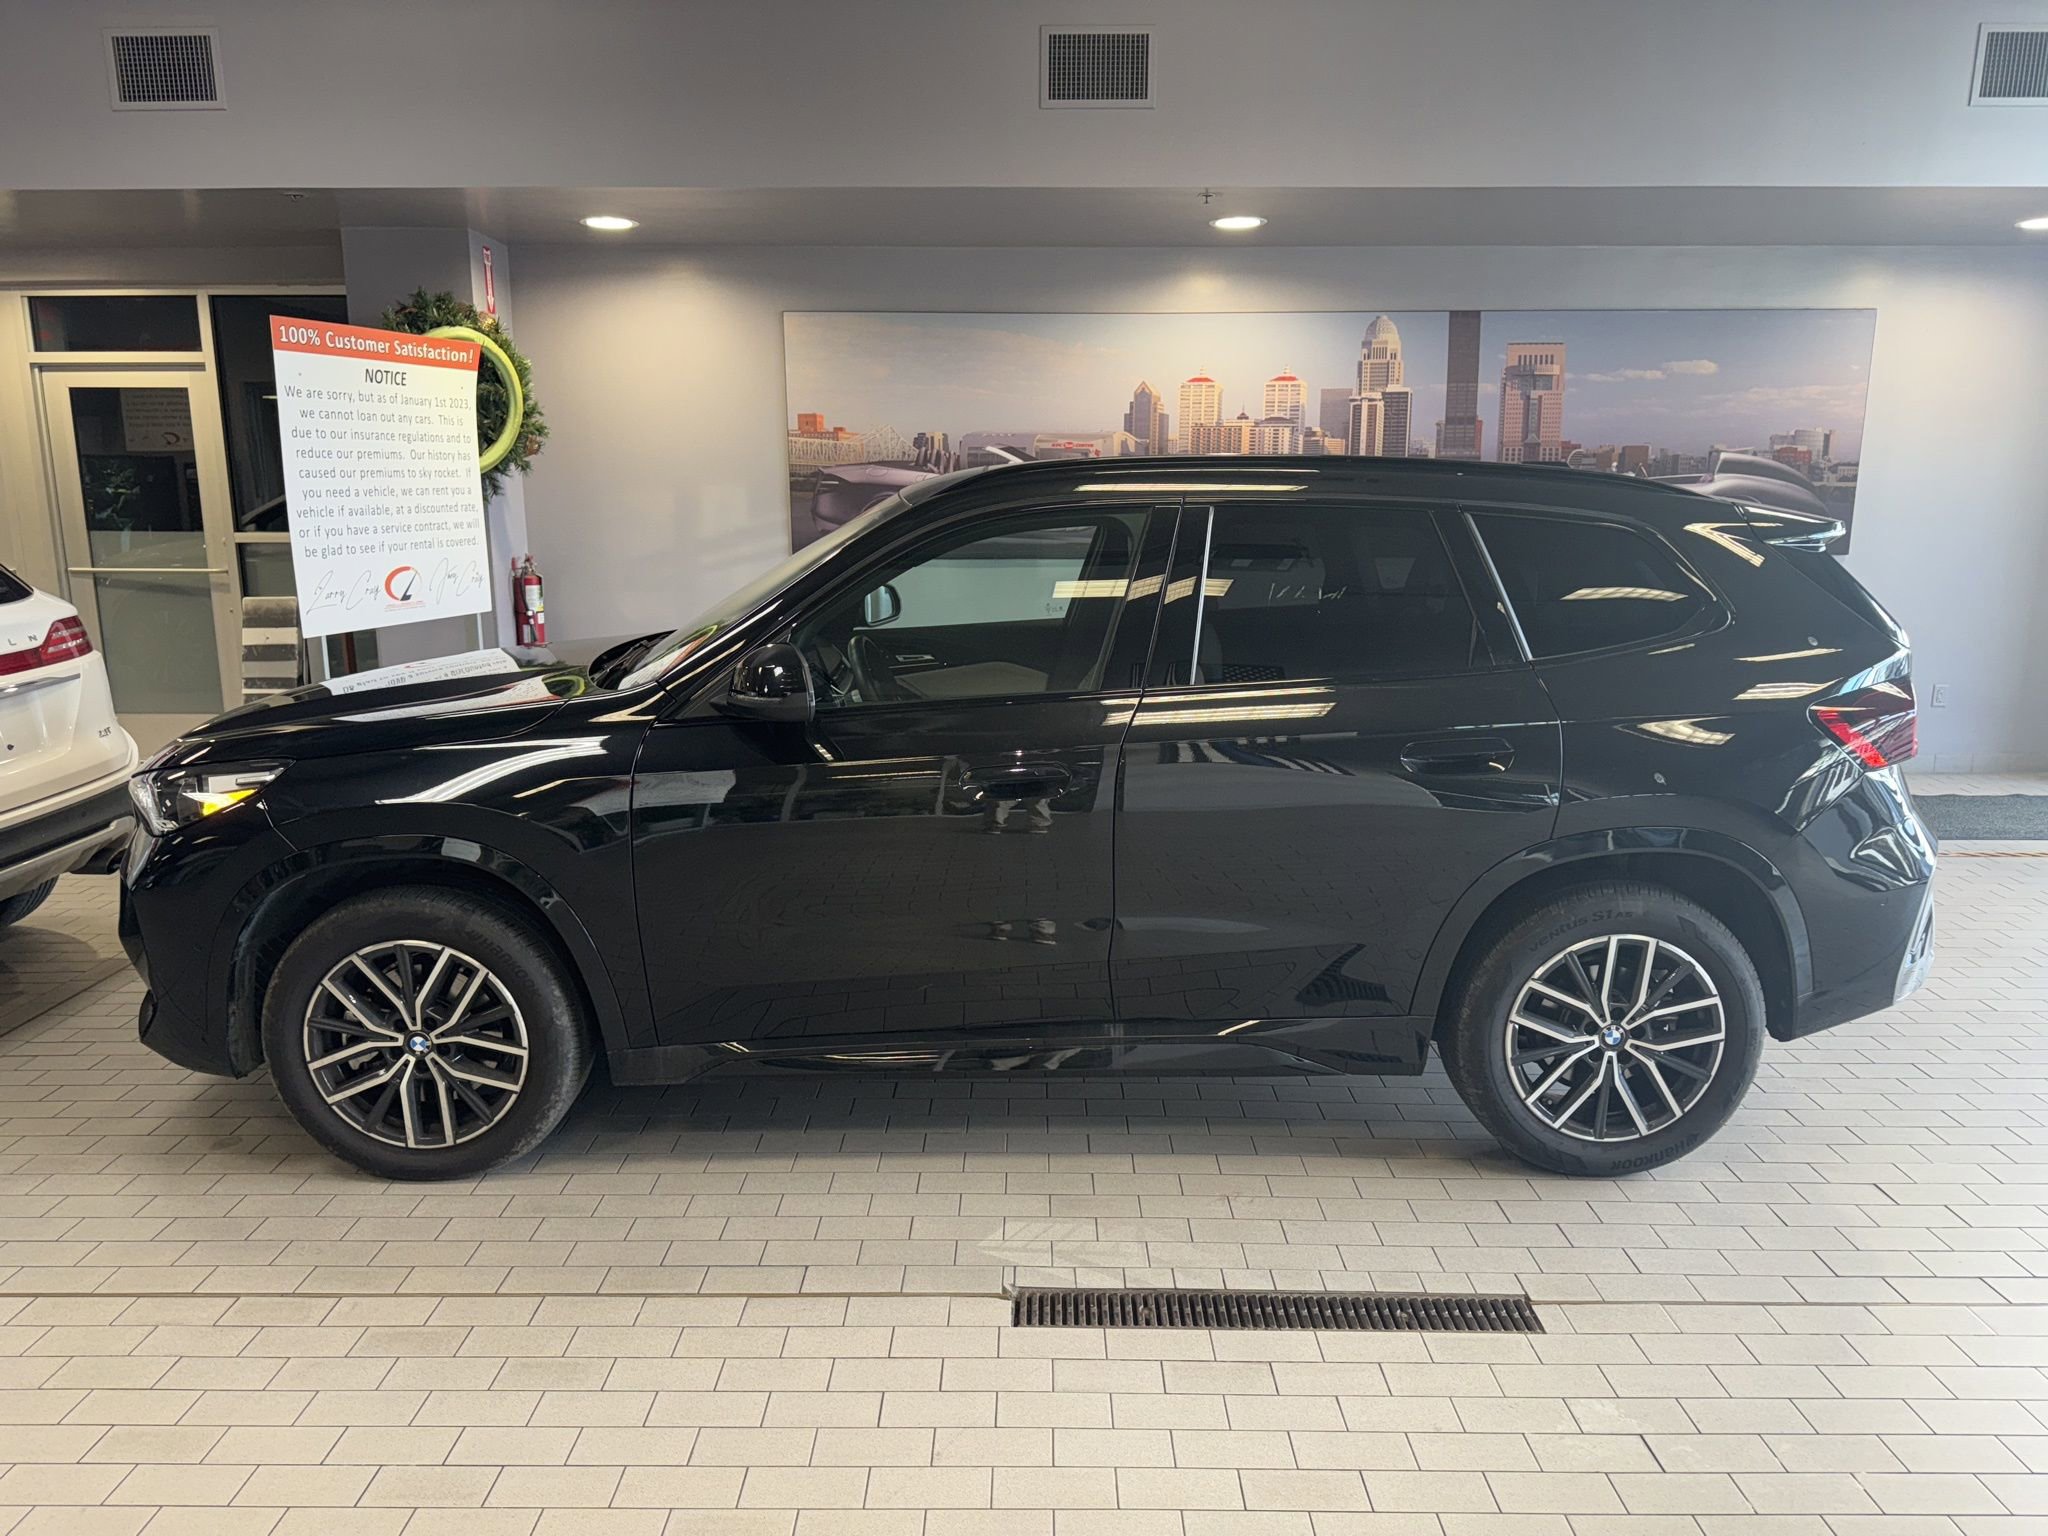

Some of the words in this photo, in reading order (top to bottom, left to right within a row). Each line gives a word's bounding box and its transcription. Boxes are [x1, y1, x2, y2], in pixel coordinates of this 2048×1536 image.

[279, 325, 320, 346] 100%
[326, 332, 390, 354] Customer
[395, 340, 473, 363] Satisfaction!
[365, 368, 407, 386] NOTICE
[284, 385, 303, 398] We
[305, 389, 323, 399] are
[327, 391, 355, 404] sorry,
[358, 390, 374, 403] but
[377, 394, 386, 404] as
[389, 393, 400, 404] of
[401, 394, 432, 408] January
[435, 397, 447, 408] 1st
[449, 398, 471, 410] 2023,
[299, 409, 315, 420] we
[319, 408, 354, 421] cannot
[357, 410, 379, 422] loan
[380, 412, 395, 422] out
[398, 414, 412, 426] any
[415, 416, 434, 424] cars.
[438, 414, 454, 426] This
[457, 416, 463, 426] is
[291, 426, 314, 440] due
[315, 428, 326, 439] to
[330, 430, 348, 440] our
[350, 428, 395, 441] insurance
[399, 431, 444, 444] regulations
[446, 433, 460, 443] and
[463, 435, 471, 444] to
[296, 446, 333, 461] reduce
[336, 448, 353, 461] our
[357, 448, 405, 462] premiums.
[410, 449, 425, 460] Our
[428, 449, 455, 463] history
[457, 450, 471, 461] has
[299, 467, 338, 479] caused
[339, 468, 356, 478] our
[360, 467, 405, 480] premiums
[408, 468, 416, 478] to
[419, 467, 432, 480] sky
[434, 467, 461, 478] rocket.
[466, 468, 471, 477] If
[302, 489, 324, 502] you
[325, 485, 351, 498] need
[354, 489, 360, 497] a
[362, 485, 398, 498] vehicle,
[401, 488, 413, 496] we
[416, 488, 430, 496] can
[432, 486, 448, 495] rent
[451, 487, 465, 496] you
[466, 487, 472, 495] a
[296, 504, 336, 518] vehicle
[338, 505, 344, 517] if
[348, 504, 393, 519] available,
[396, 505, 404, 515] at
[407, 506, 412, 514] a
[415, 502, 458, 514] discounted
[461, 504, 478, 512] rate,
[299, 529, 310, 538] or
[314, 525, 321, 537] if
[324, 528, 343, 540] you
[346, 524, 369, 535] have
[373, 526, 380, 536] a
[381, 522, 412, 536] service
[414, 521, 451, 535] contract,
[466, 519, 479, 528] will
[304, 545, 318, 557] be
[321, 544, 343, 559] glad
[346, 545, 356, 555] to
[360, 545, 375, 554] see
[379, 541, 385, 552] if
[388, 543, 407, 554] your
[410, 537, 435, 550] rental
[437, 537, 443, 548] is
[446, 536, 478, 547] covered.
